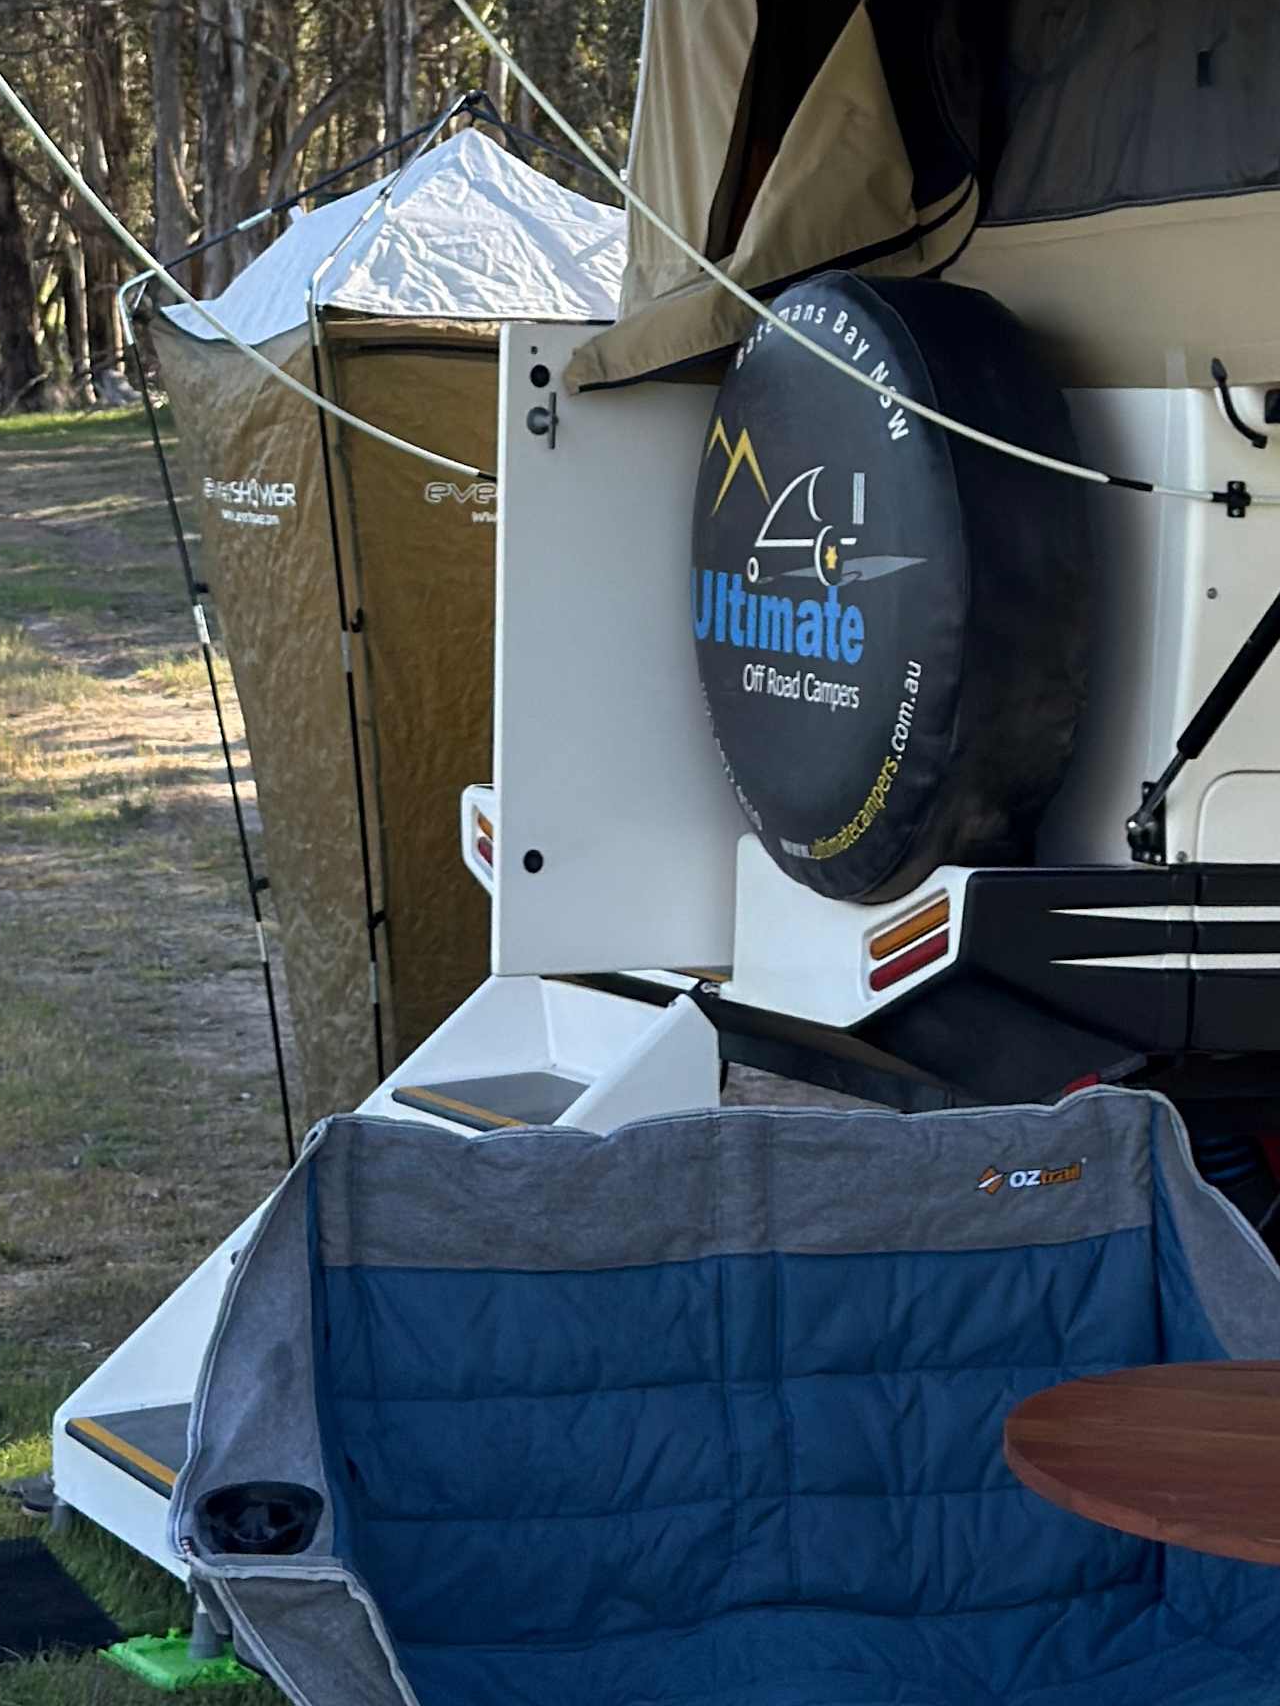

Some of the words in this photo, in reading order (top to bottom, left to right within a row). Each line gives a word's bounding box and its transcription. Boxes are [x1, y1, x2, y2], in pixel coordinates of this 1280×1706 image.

[832, 310, 870, 362] Bay
[870, 360, 910, 441] NSW
[691, 568, 865, 665] Ultimate
[742, 662, 767, 692] Off
[766, 666, 802, 700] Road
[803, 672, 860, 713] Campers
